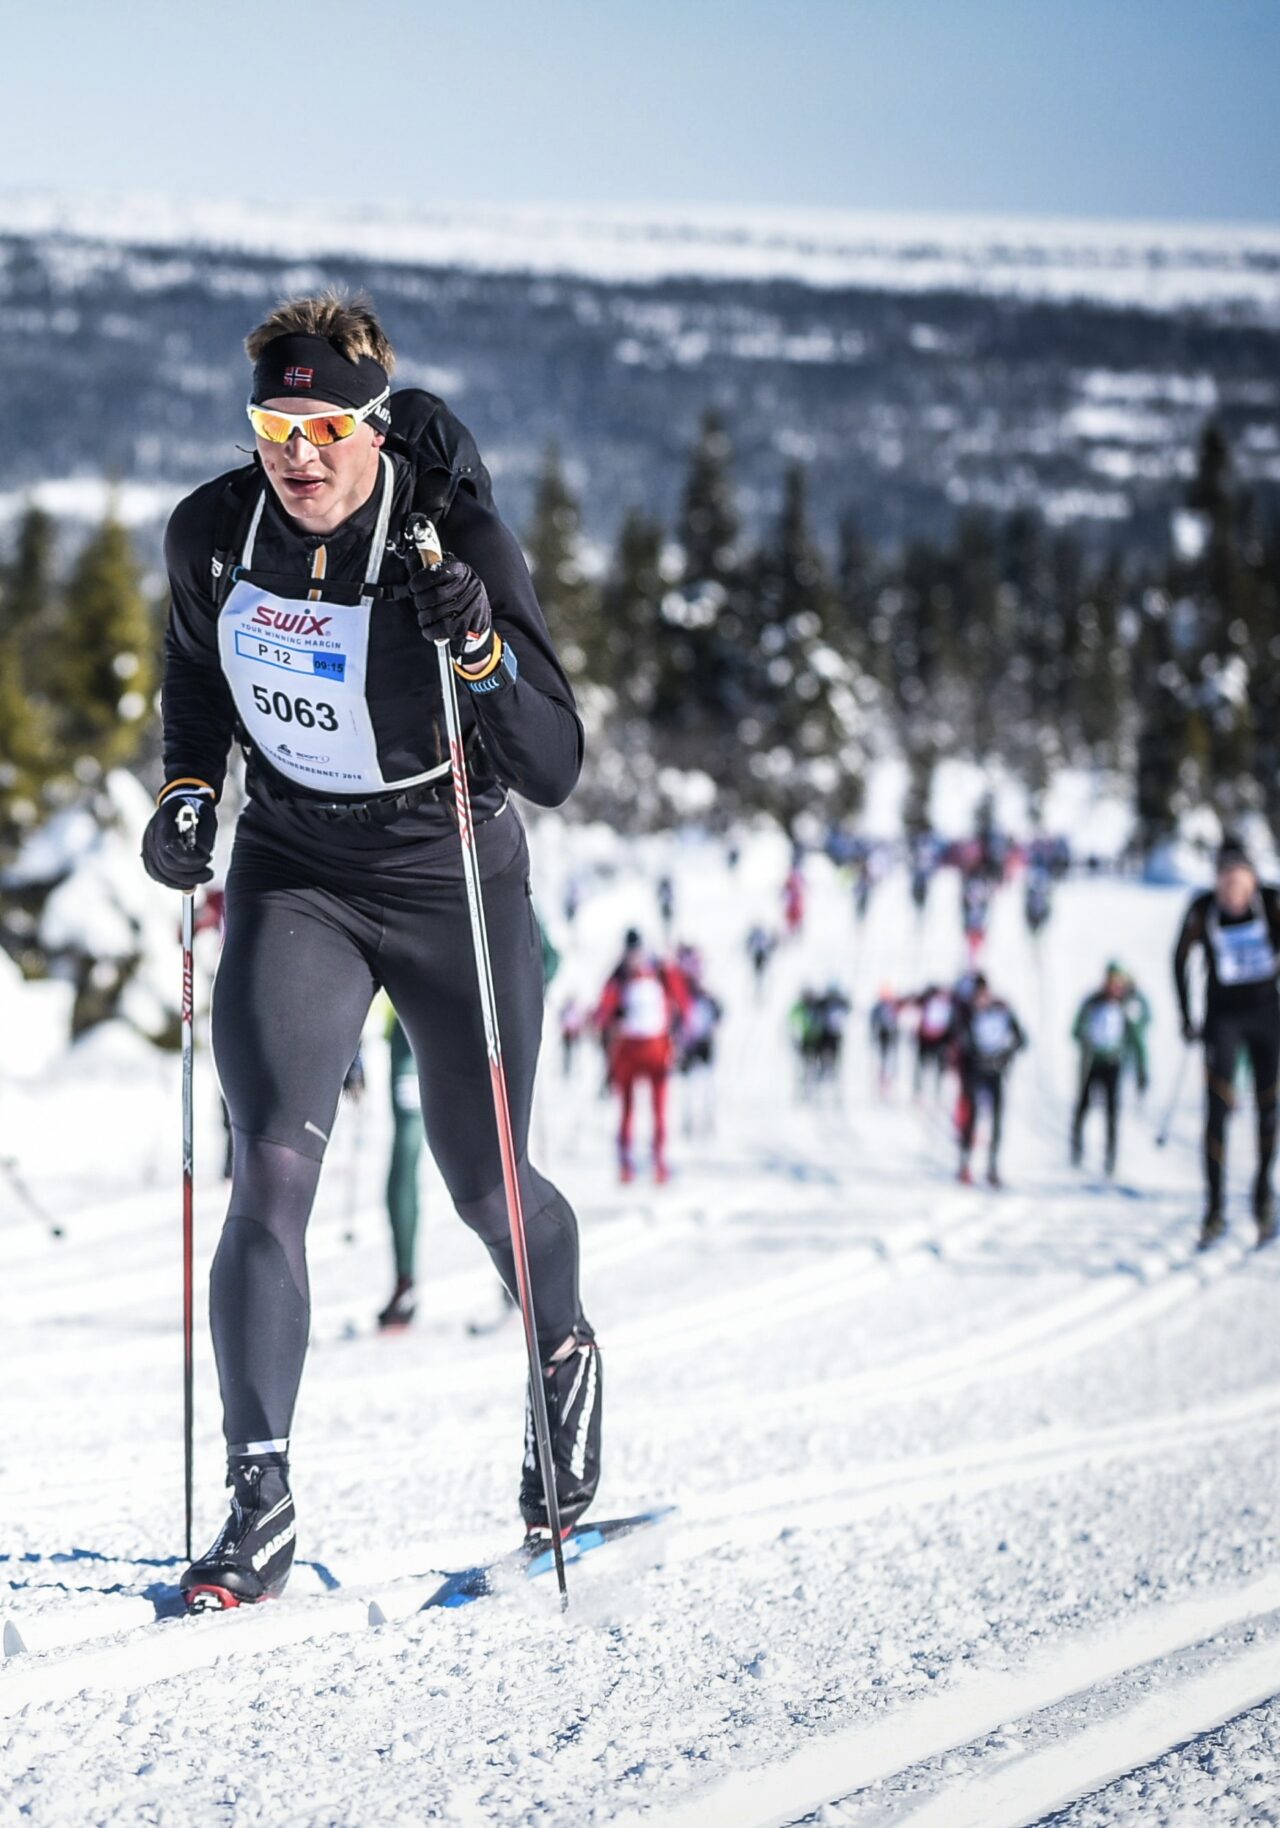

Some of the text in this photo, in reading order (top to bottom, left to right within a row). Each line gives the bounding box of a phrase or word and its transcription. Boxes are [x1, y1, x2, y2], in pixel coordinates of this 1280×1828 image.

[241, 622, 341, 649] YOUR WINNING MARGIN
[251, 606, 332, 636] SWIX
[258, 643, 345, 673] P 12 09:15
[252, 684, 339, 732] 5063
